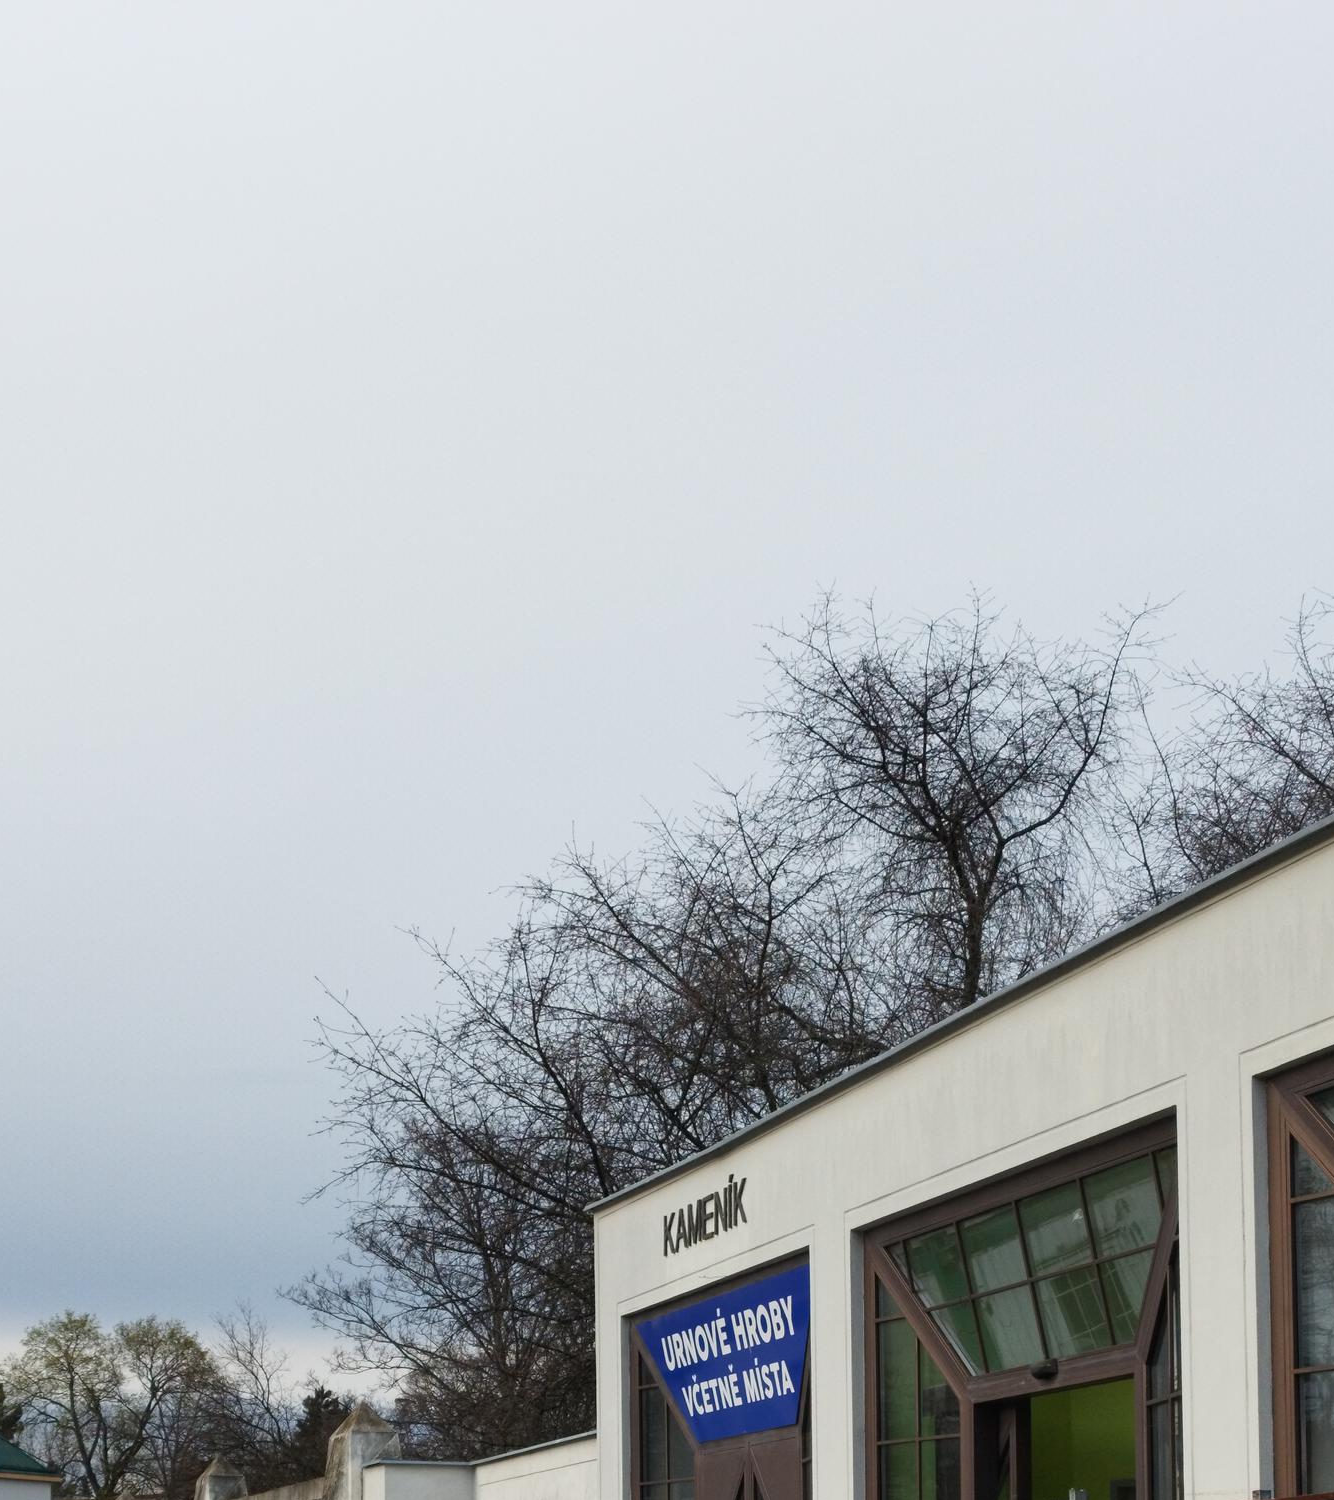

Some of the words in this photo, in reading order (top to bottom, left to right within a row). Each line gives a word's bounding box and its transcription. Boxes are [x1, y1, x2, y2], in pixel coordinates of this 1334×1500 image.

[663, 1173, 748, 1257] KAMENÍK
[660, 1307, 732, 1372] URNOVÉ
[730, 1295, 795, 1351] HROBY
[681, 1363, 743, 1418] VČETNĚ
[742, 1357, 796, 1404] MÍSTA
